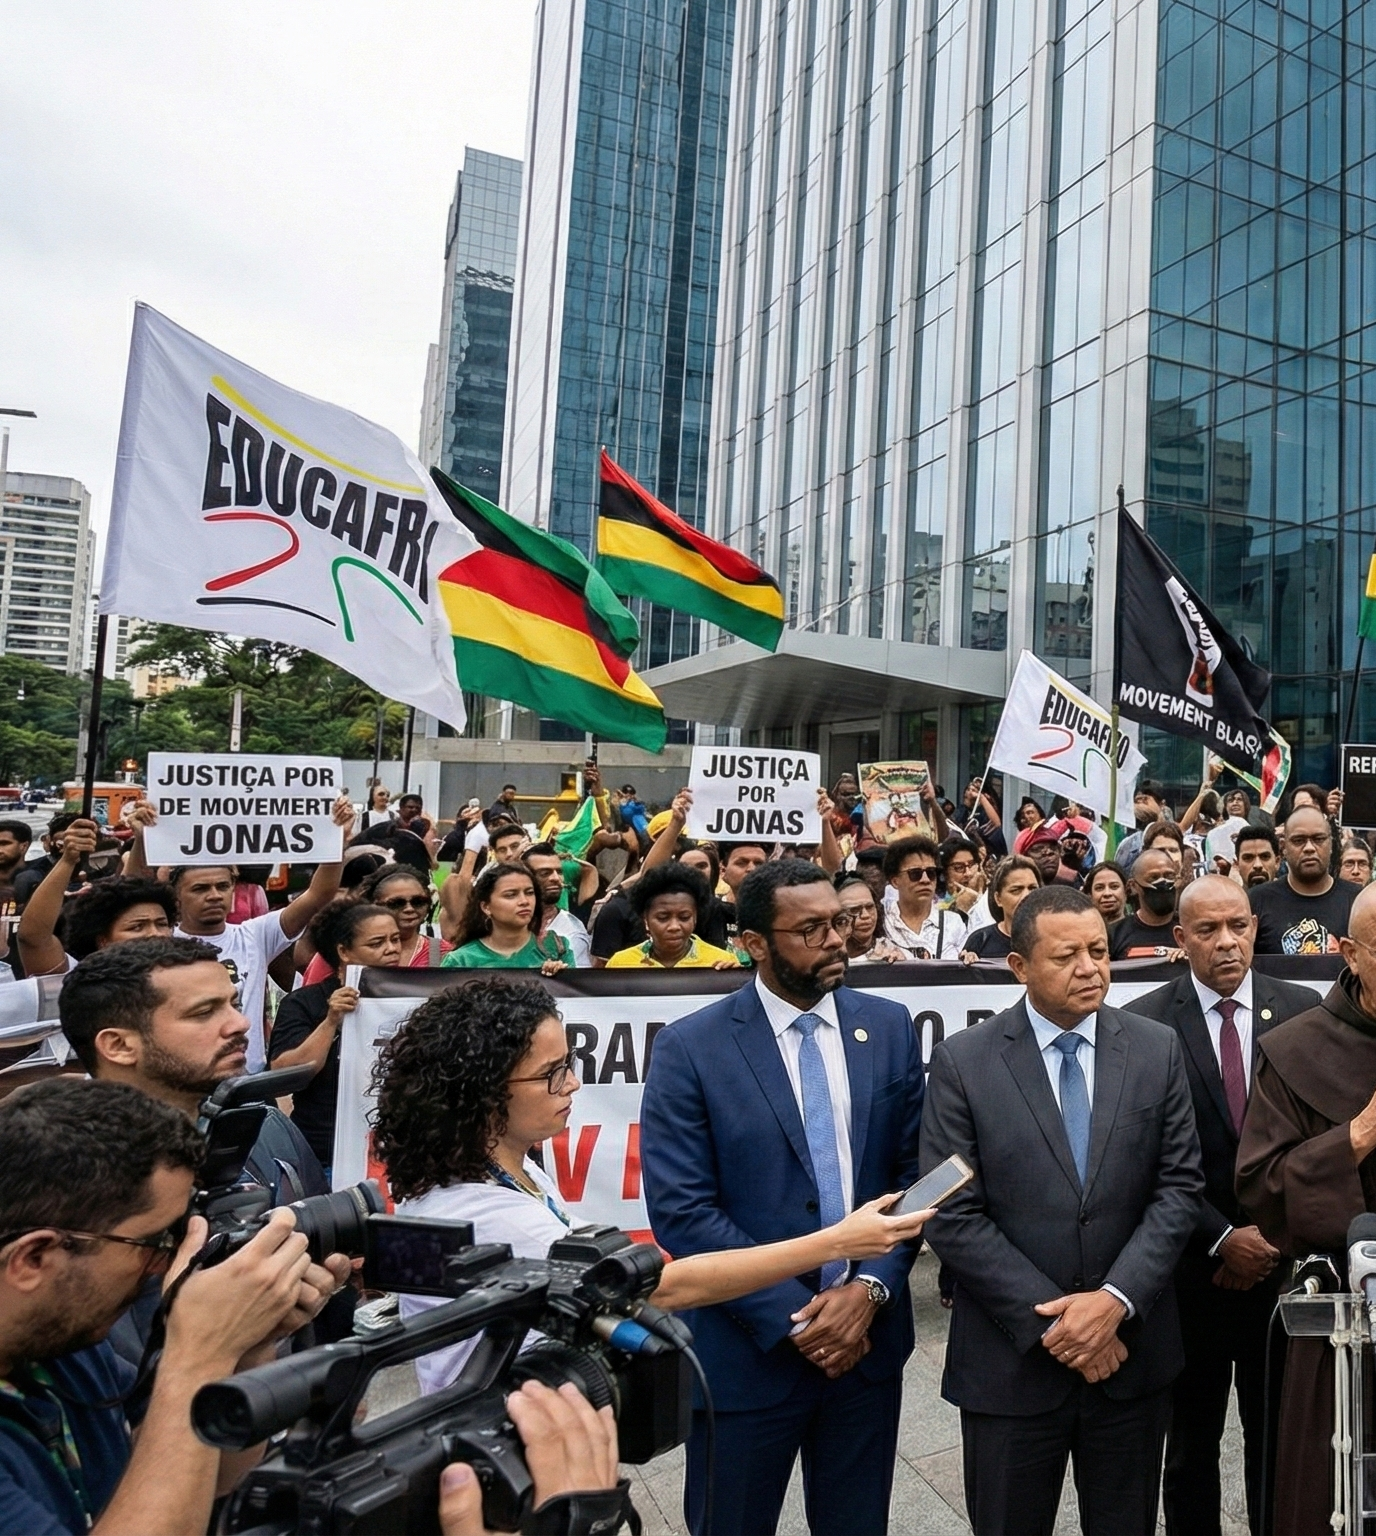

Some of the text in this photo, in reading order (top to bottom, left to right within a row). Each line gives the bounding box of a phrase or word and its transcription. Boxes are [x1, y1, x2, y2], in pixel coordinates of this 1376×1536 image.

[1119, 682, 1213, 732] MOVEMENT
[158, 764, 334, 793] JUSTIÇA POR
[703, 754, 810, 787] JUSTIÇA
[160, 798, 191, 815] DE
[738, 785, 775, 803] POR
[706, 808, 804, 836] JONAS
[180, 823, 314, 855] JONAS
